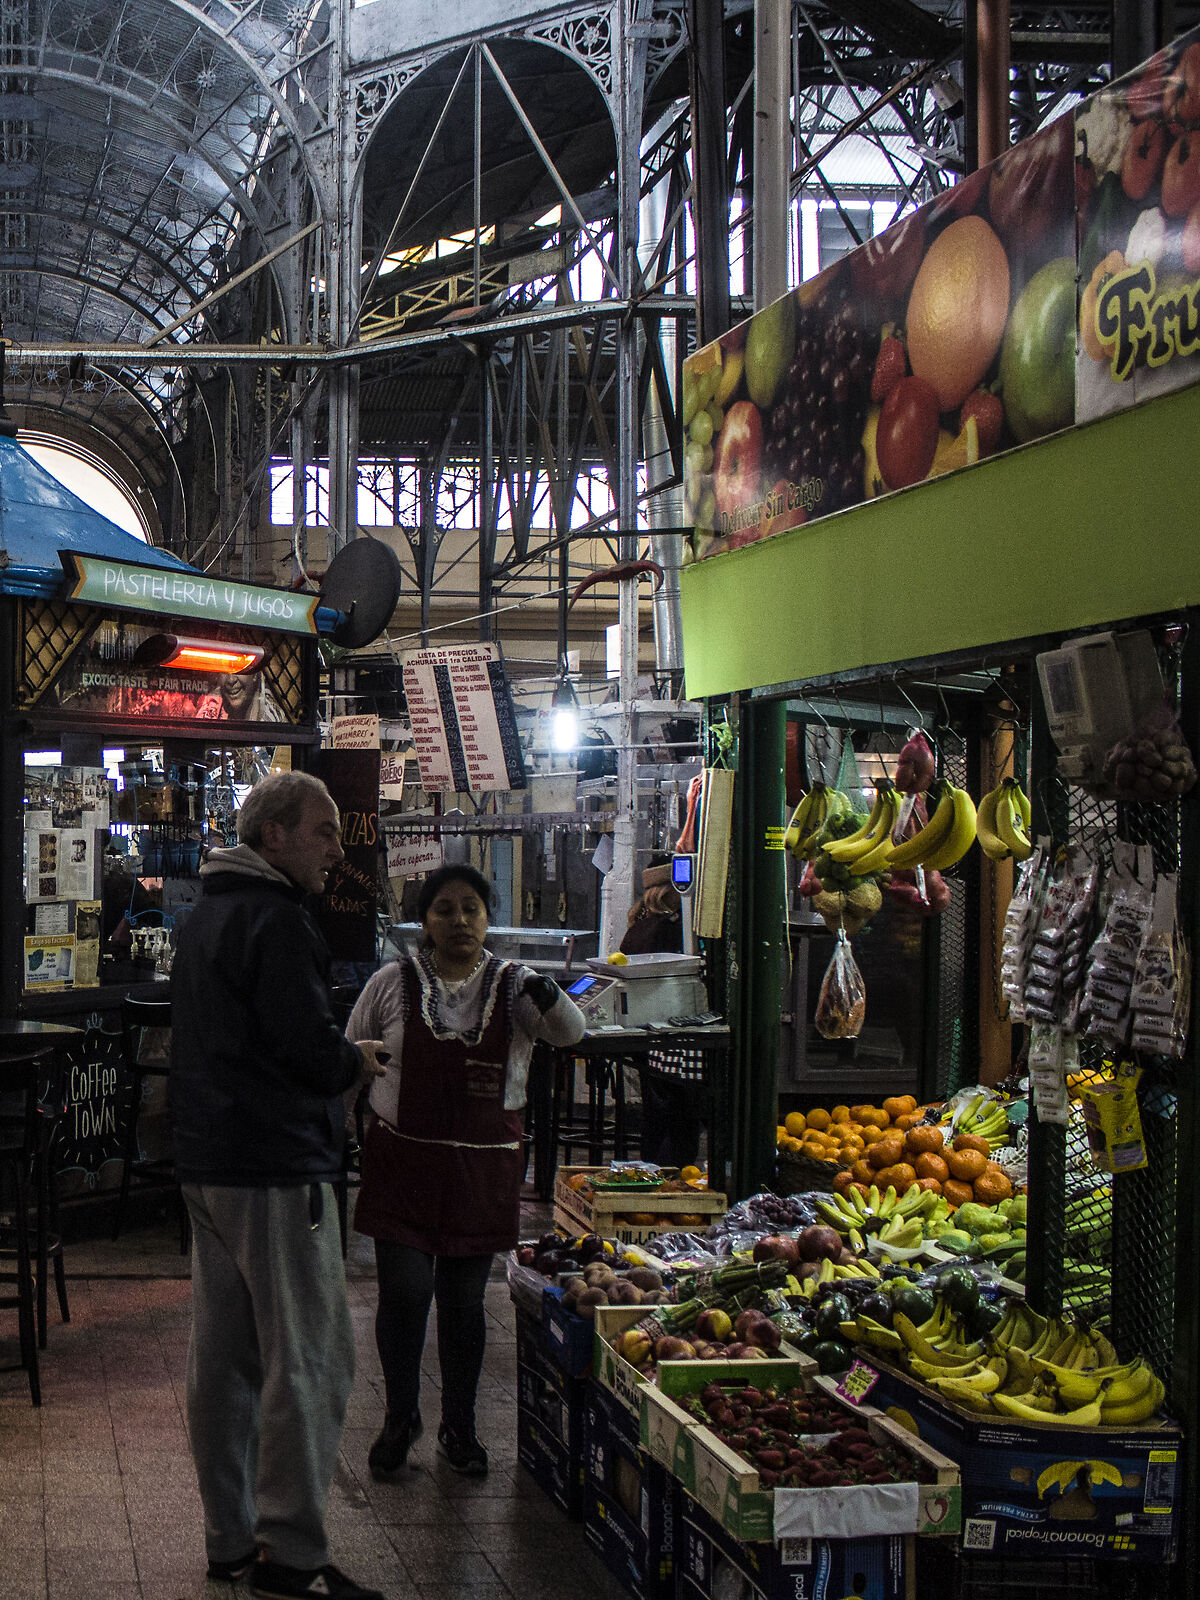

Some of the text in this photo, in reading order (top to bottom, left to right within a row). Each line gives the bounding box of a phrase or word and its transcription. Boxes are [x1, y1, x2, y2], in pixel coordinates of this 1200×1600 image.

[719, 477, 824, 538] Delivery Sin Cargo
[104, 567, 218, 609] PASTELERIA
[236, 591, 294, 619] JUGOS
[448, 649, 478, 657] PRECIOS
[462, 655, 492, 663] CALIDAD
[81, 673, 116, 686] EXOTIC
[118, 675, 148, 689] TASTE
[159, 678, 178, 690] FAIR
[181, 679, 208, 692] TRADE
[381, 757, 396, 769] DE
[981, 1504, 1039, 1520] EXTRA PREMIUM
[1005, 1526, 1105, 1547] BananaTropical
